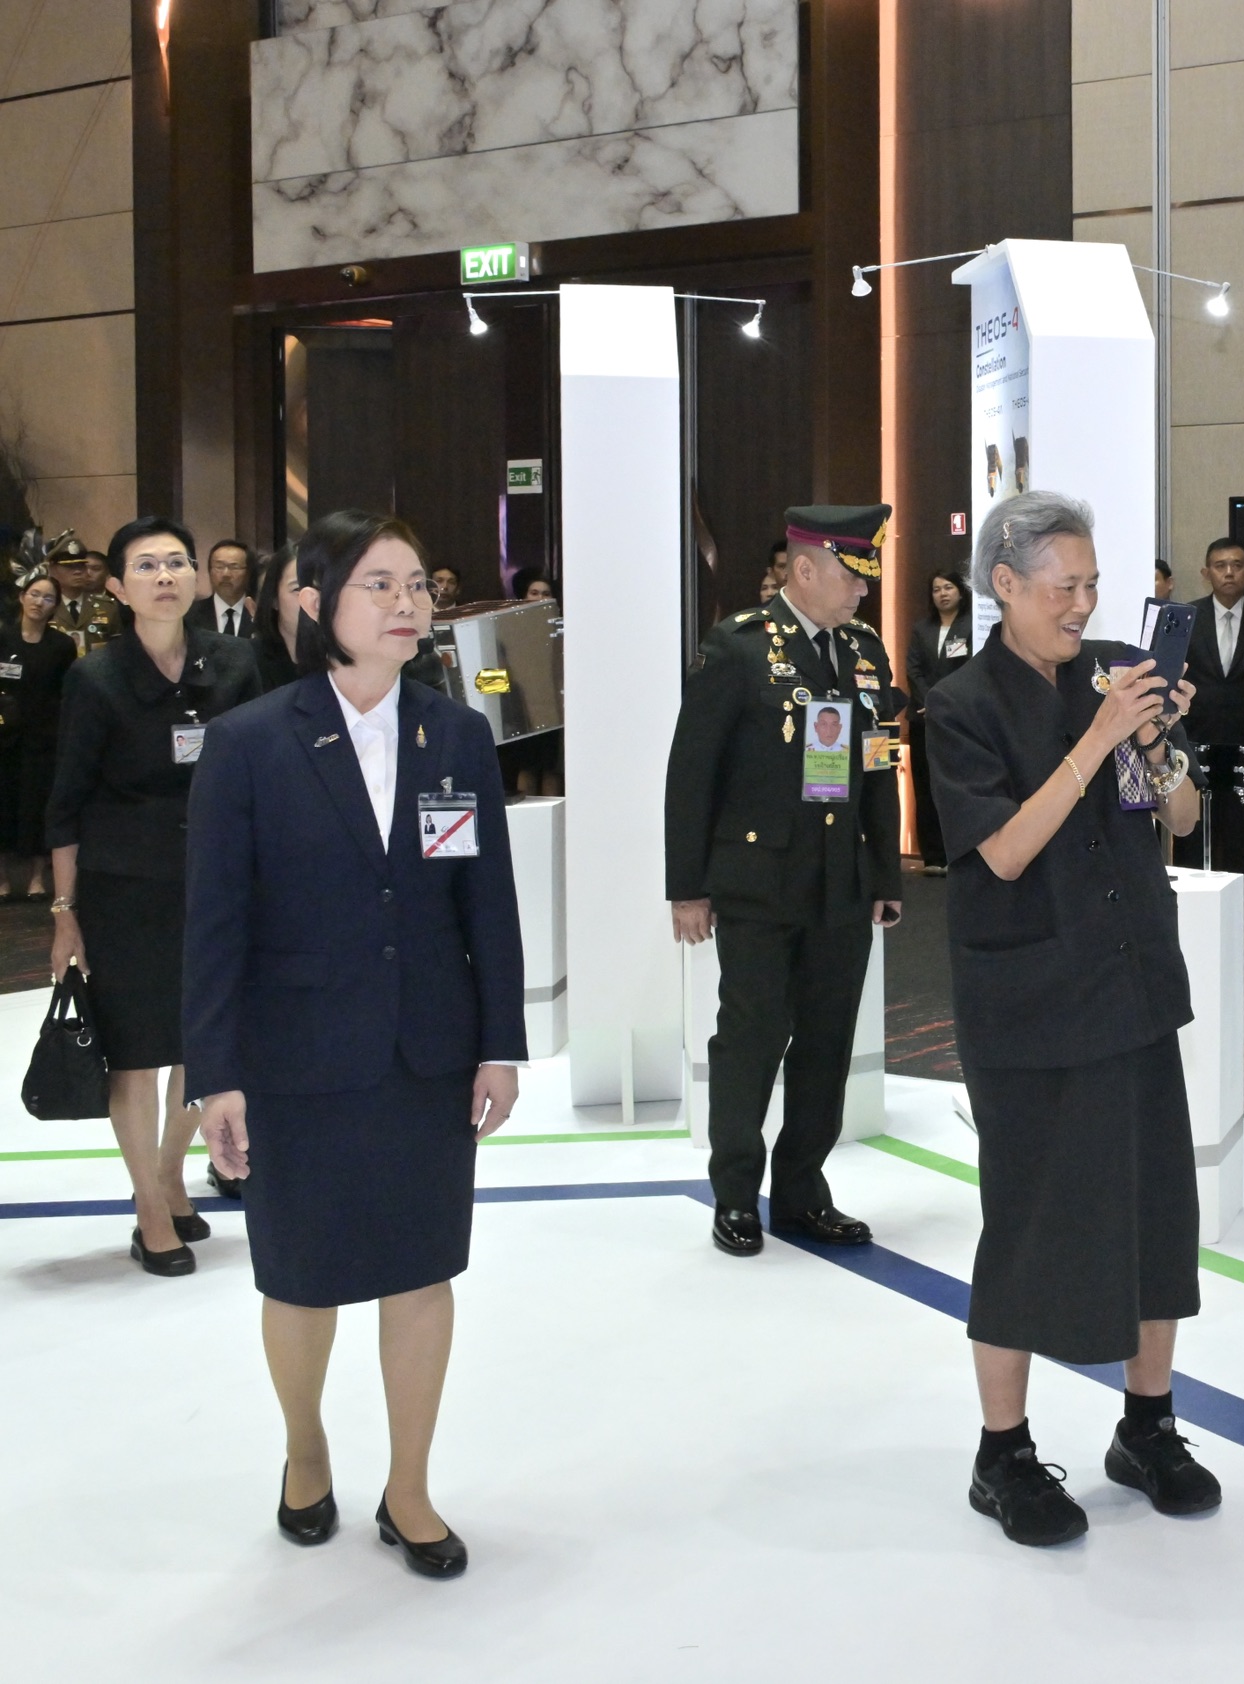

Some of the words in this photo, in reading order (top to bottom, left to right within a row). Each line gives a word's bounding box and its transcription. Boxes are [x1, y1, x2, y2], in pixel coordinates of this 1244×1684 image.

[465, 249, 512, 279] EXIT
[976, 307, 1018, 349] THEOS-4
[976, 354, 1006, 378] Constellation
[509, 473, 526, 482] Exit
